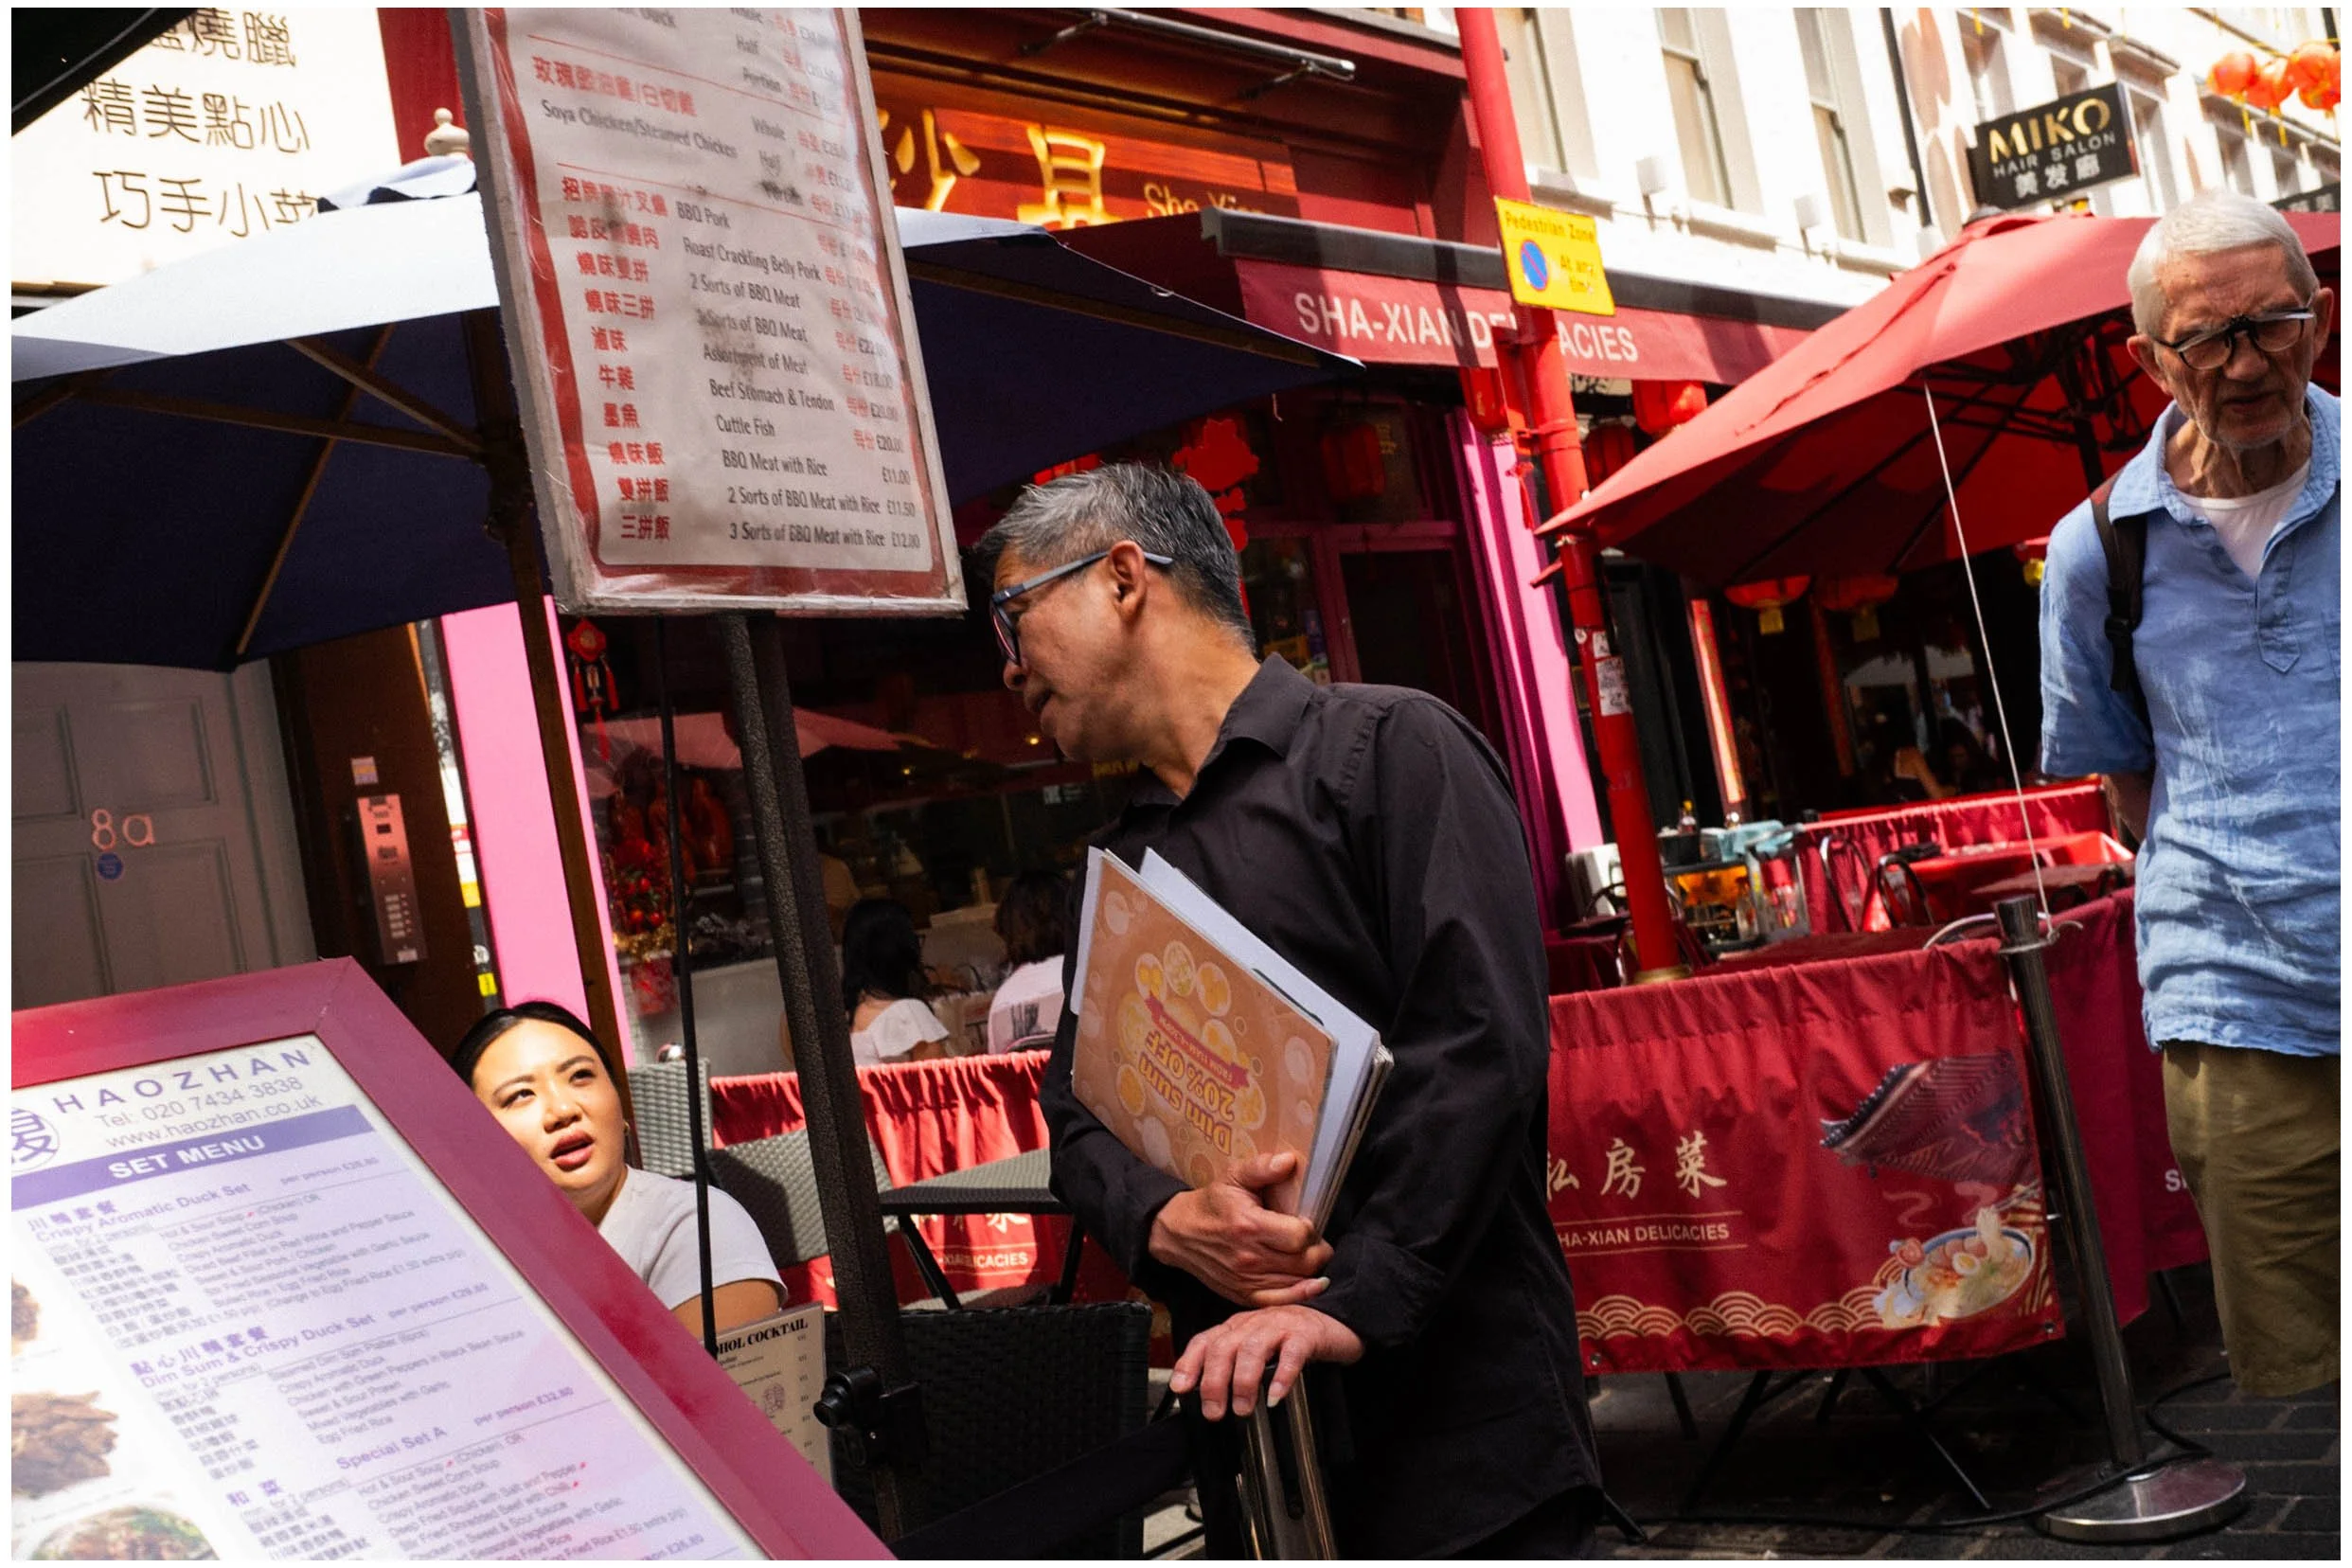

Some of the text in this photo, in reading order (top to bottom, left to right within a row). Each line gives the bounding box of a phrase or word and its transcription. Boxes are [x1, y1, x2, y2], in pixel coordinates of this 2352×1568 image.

[150, 9, 296, 67] 燒臘
[80, 78, 310, 154] 精美點心
[543, 100, 576, 125] Soya
[1989, 98, 2111, 165] MIKO
[1992, 131, 2116, 178] HAIR SALON
[677, 203, 729, 227] BBQ Pork
[1505, 210, 1595, 243] Pedestrian Zone
[684, 238, 820, 280] Roast Crackling Belly Pork
[1559, 255, 1574, 271] At
[691, 274, 800, 307] 2 Sorts of BBQ Meat
[739, 316, 751, 332] of
[756, 318, 776, 336] BBQ
[780, 322, 807, 340] Meat
[1294, 292, 1639, 363] SHA-XIAN DACIES
[769, 354, 780, 369] of
[783, 356, 808, 373] Meat
[710, 381, 834, 410] Beef Stomach & Tendon
[717, 416, 775, 436] Cuttle Fish
[722, 451, 827, 474] BBQ Meat with Rice
[882, 468, 910, 484] £11.00
[728, 488, 880, 512] 2 Sorts of BBQ Meat with Rice
[887, 501, 916, 516] £11.50
[730, 524, 884, 545] 3 Sorts of BBQ Meat with Rice
[92, 809, 155, 850] 8a
[1146, 1029, 1185, 1080] OFF
[52, 1049, 312, 1114] HAOZHAN
[94, 1076, 304, 1128] Tel: 020 7434 3838
[1185, 1062, 1236, 1122] 20%
[104, 1094, 323, 1149] www.haozhan.co.uk
[1139, 1051, 1233, 1156] Dim sum
[107, 1134, 267, 1180] SET MENU
[34, 1221, 94, 1243] Crispy
[98, 1202, 173, 1226] Aromatic
[175, 1189, 218, 1206] Duck
[222, 1182, 249, 1195] Set
[1559, 1223, 1730, 1248] HA-XIAN DELICACIES
[140, 1369, 177, 1388] Dim
[180, 1356, 223, 1376] Sum
[223, 1350, 241, 1363] &
[241, 1333, 299, 1359] Crispy
[301, 1321, 344, 1341] Duck
[347, 1312, 374, 1327] Set
[717, 1318, 809, 1355] HOL COCKTAIL
[335, 1440, 401, 1471] Special
[401, 1431, 430, 1449] Set
[430, 1425, 447, 1438] A
